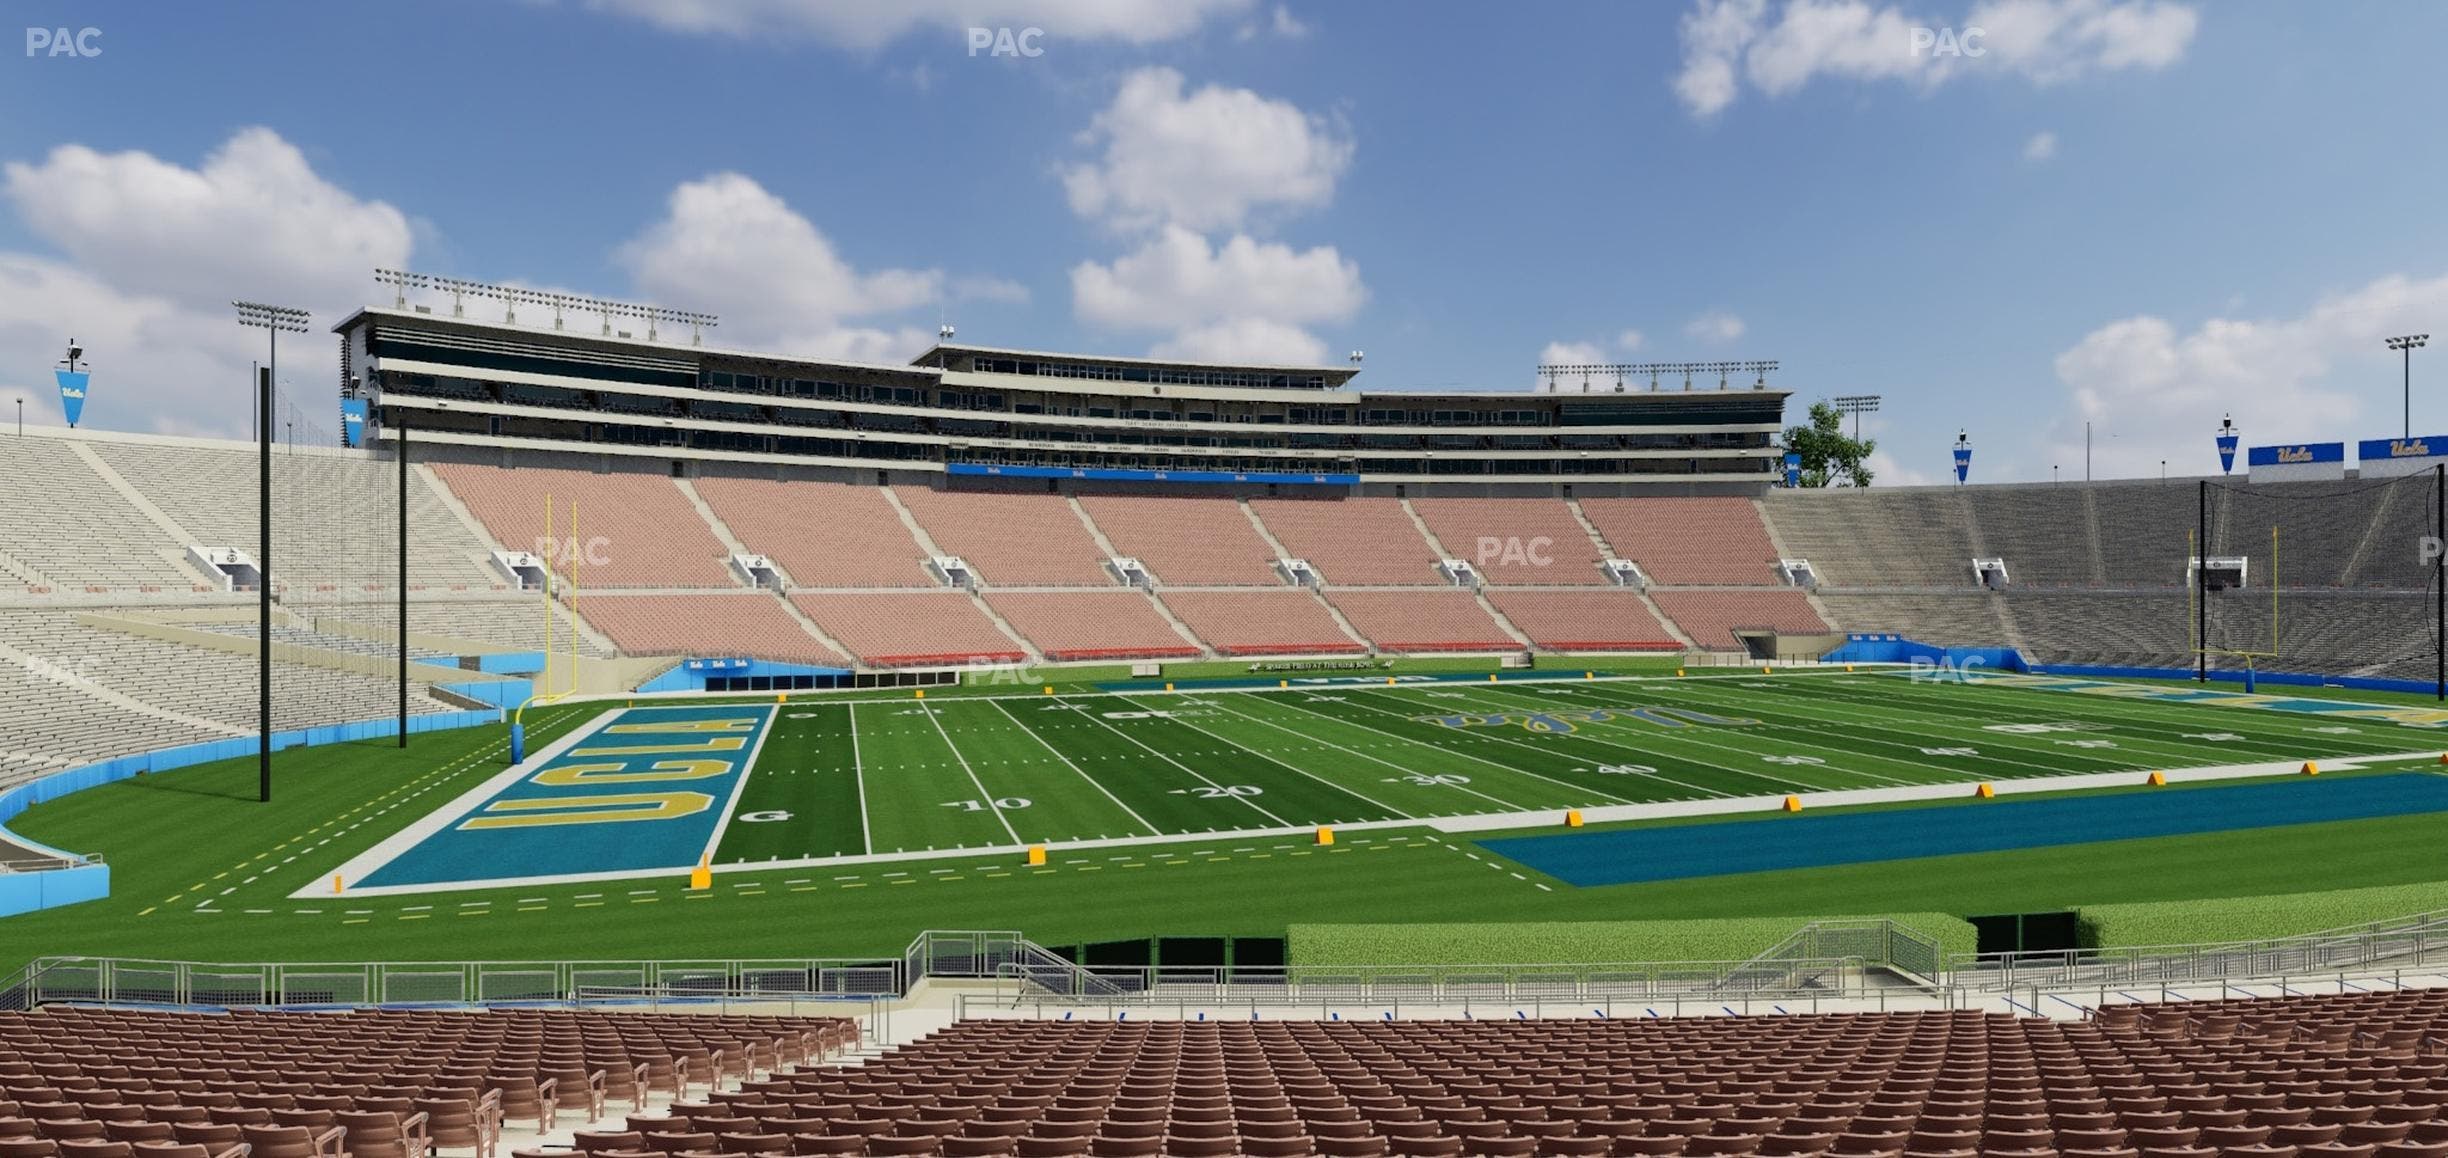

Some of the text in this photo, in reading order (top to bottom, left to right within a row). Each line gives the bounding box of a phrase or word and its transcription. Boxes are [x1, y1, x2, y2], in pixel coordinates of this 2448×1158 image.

[2278, 447, 2313, 462] Ucla
[2391, 439, 2429, 457] Ucla
[455, 718, 760, 830] UCLA
[1599, 764, 1658, 775] 40
[1402, 774, 1471, 787] 30
[1190, 785, 1264, 798] 20
[958, 798, 1032, 812] 10
[738, 810, 795, 823] G
